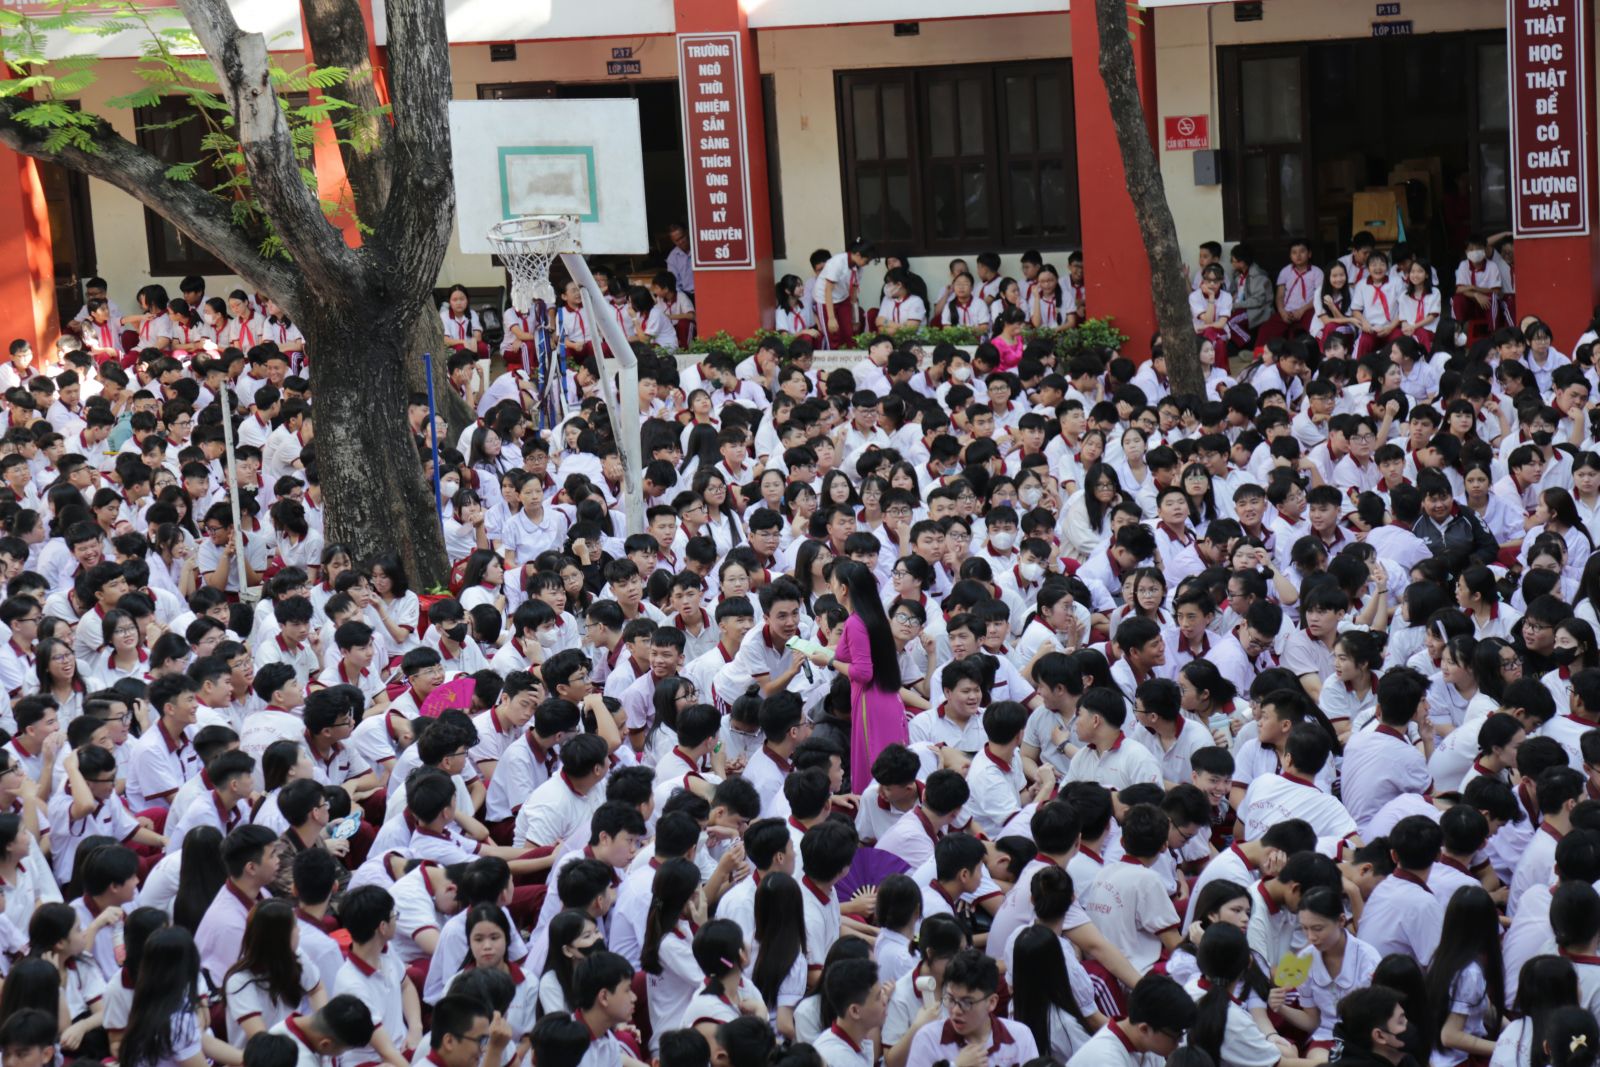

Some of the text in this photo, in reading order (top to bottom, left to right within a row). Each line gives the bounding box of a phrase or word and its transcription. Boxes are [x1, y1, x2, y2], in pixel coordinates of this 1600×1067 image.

[1525, 14, 1566, 37] THẬT
[687, 43, 730, 58] TRƯỜNG
[1529, 44, 1563, 64] HỌC
[698, 61, 721, 76] NGÔ
[699, 80, 723, 94] THỜI
[1526, 68, 1567, 91] THẬT
[695, 99, 730, 115] NHIỆM
[1536, 91, 1559, 114] ĐỂ
[1536, 121, 1559, 141] CÓ
[700, 136, 729, 150] SÀNG
[700, 154, 731, 168] THÍCH
[1527, 145, 1570, 168] CHẤT
[706, 172, 728, 186] ỨNG
[1521, 176, 1577, 197] LƯỢNG
[710, 190, 728, 204] VỚI
[1529, 201, 1571, 223] THẬT
[700, 226, 742, 241] NGUYÊN
[715, 243, 729, 258] SỐ
